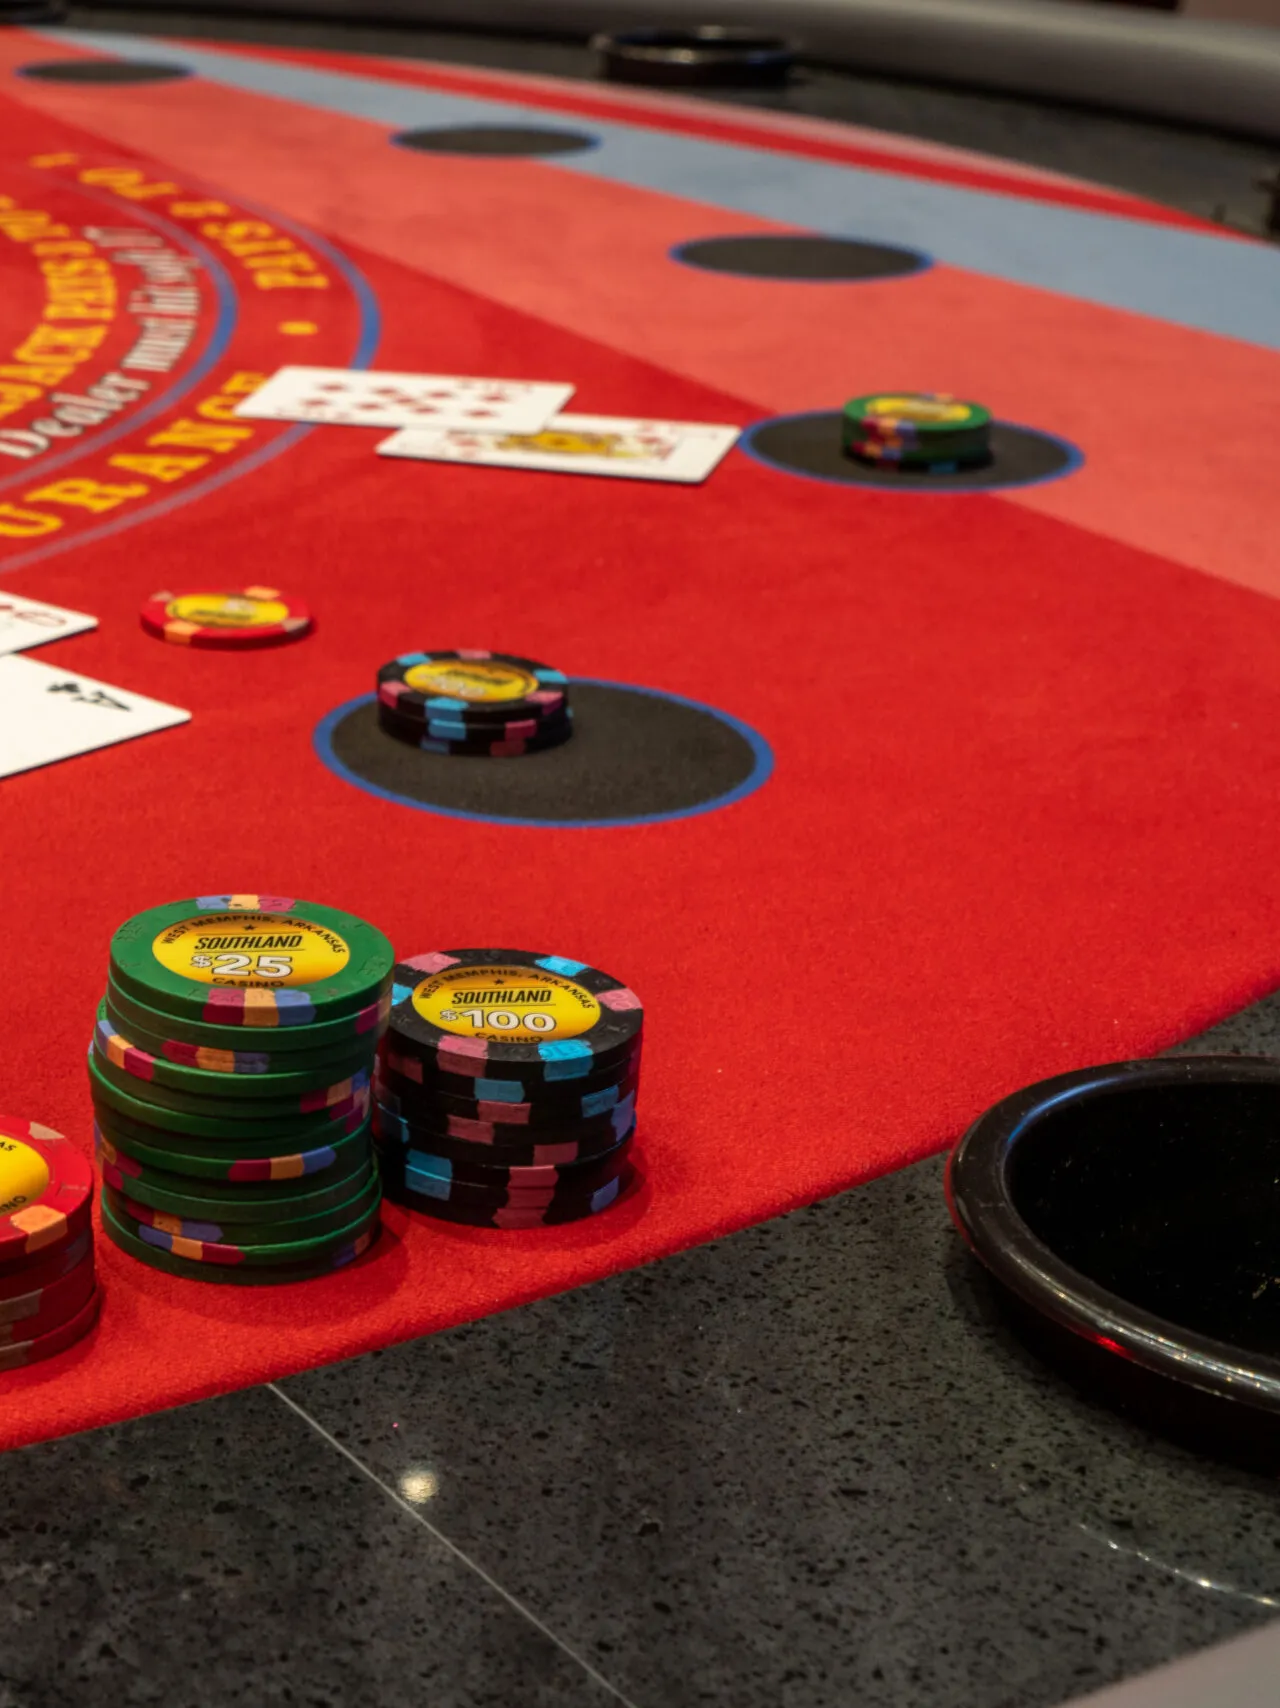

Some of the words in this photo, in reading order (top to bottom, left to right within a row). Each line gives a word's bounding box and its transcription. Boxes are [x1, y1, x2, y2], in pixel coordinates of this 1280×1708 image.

[40, 257, 118, 320] PAYS
[120, 316, 198, 373] must
[161, 925, 188, 945] WEST
[282, 918, 346, 954] ARKANSAS
[194, 935, 303, 950] SOUTHLAND
[189, 953, 294, 978] $25
[212, 977, 285, 988] CASINO
[419, 979, 444, 999] WEST
[527, 973, 596, 1010] ARKANSAS
[451, 989, 552, 1006] SOUTHLAND
[439, 1008, 557, 1033] $100
[474, 1031, 545, 1044] CASINO
